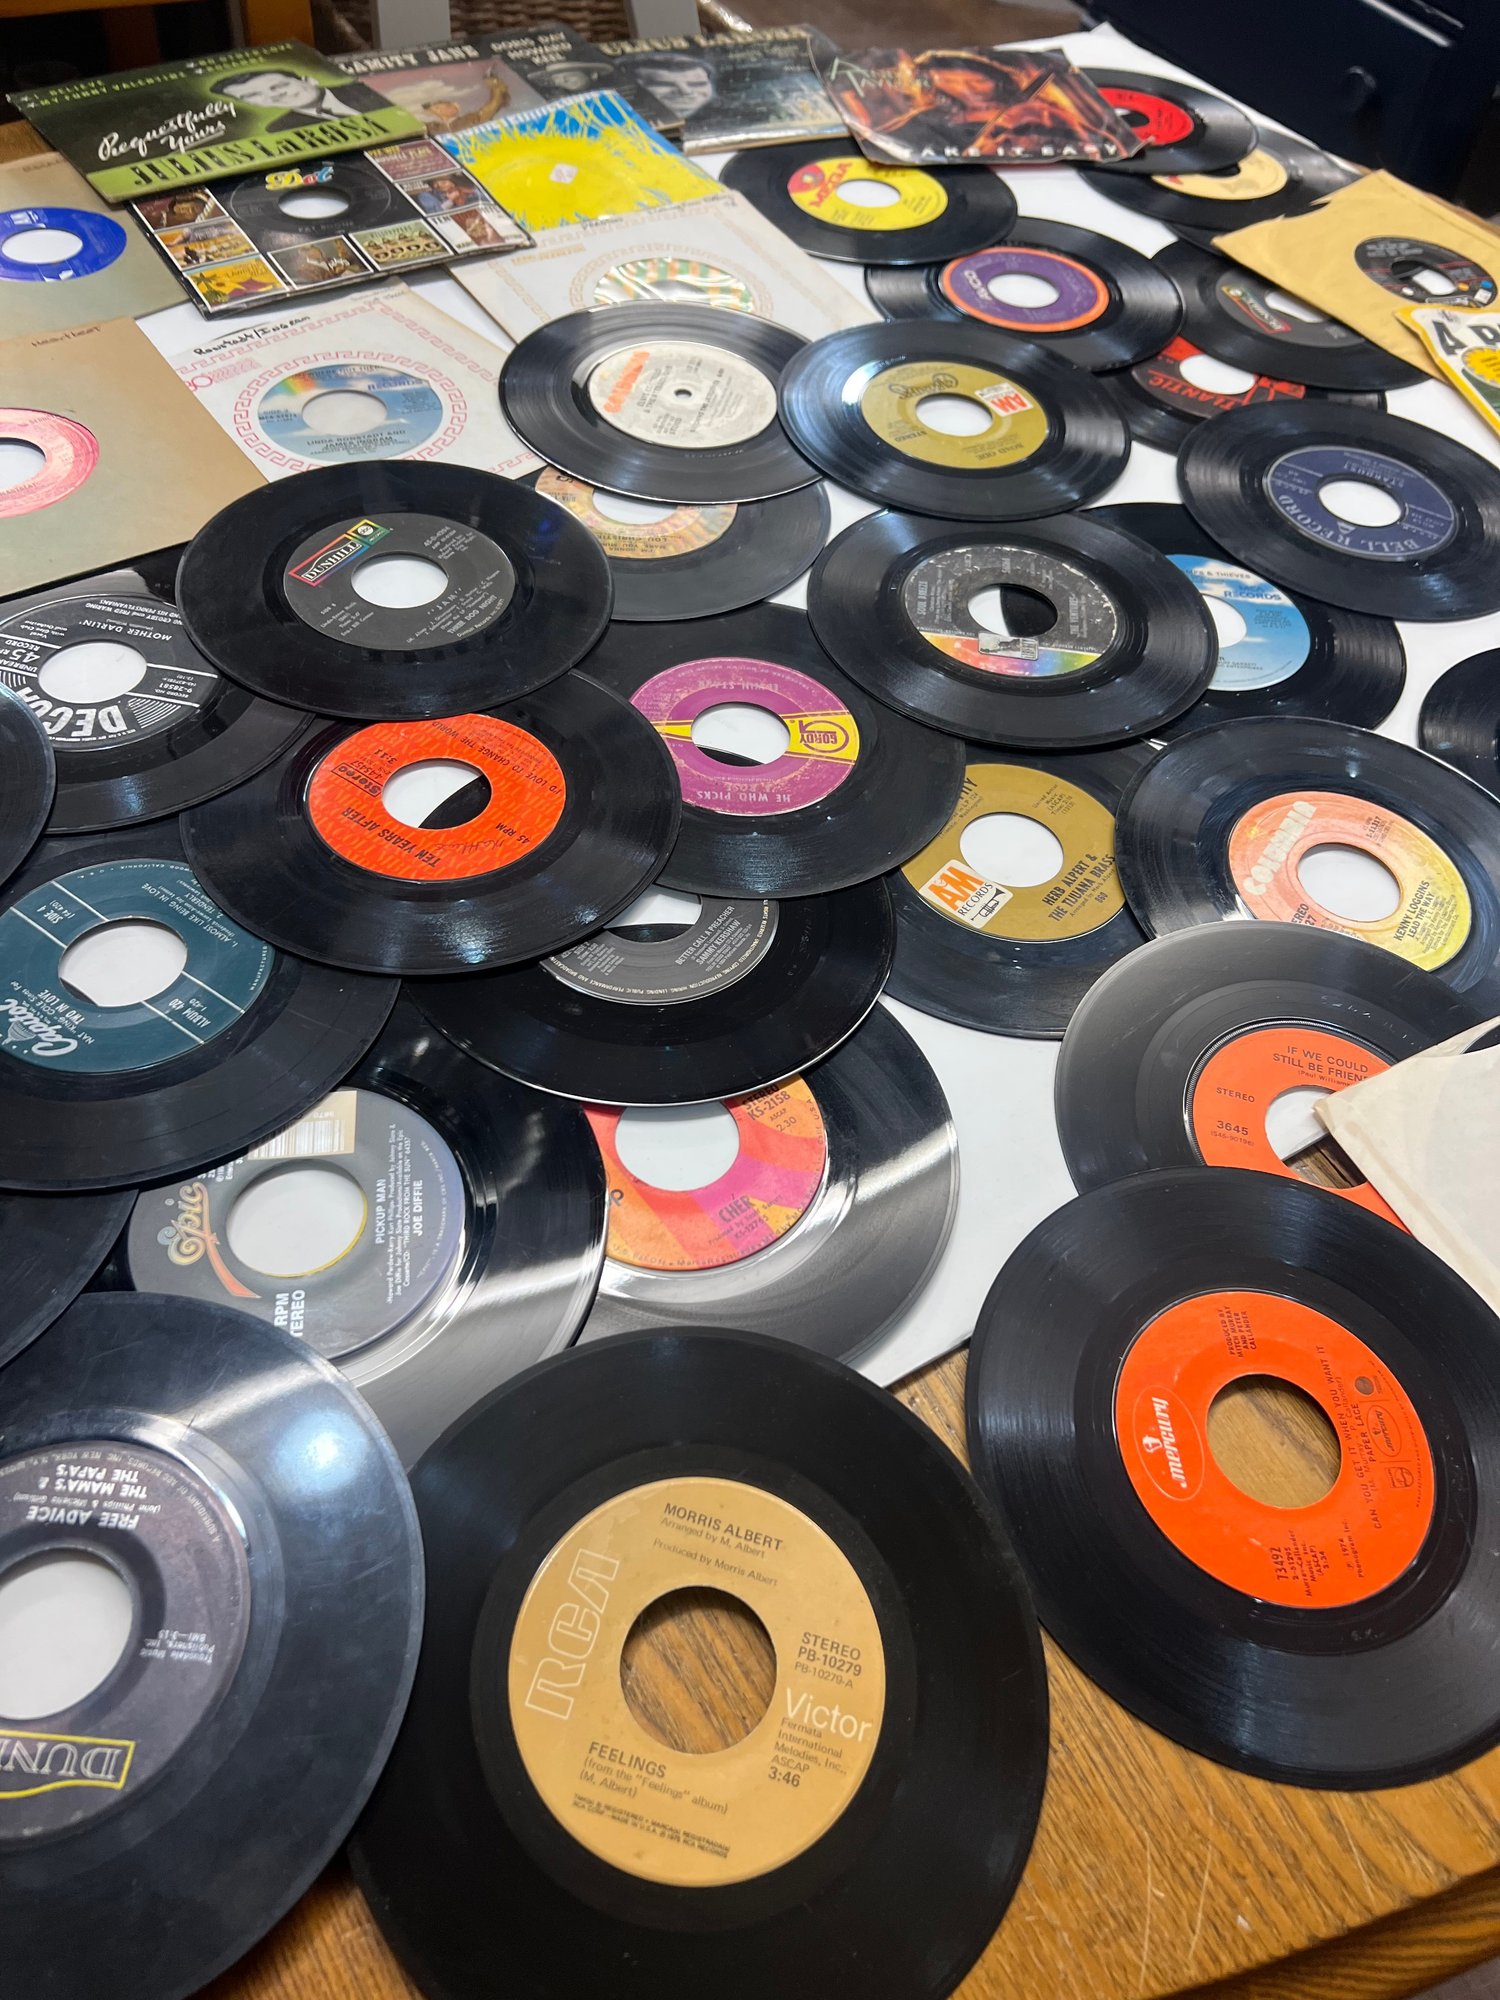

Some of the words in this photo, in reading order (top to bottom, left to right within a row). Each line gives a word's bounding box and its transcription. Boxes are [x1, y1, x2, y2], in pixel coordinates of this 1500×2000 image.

[426, 45, 479, 63] JANE
[50, 80, 105, 96] BELIEVE
[65, 87, 107, 101] FUNNY
[112, 72, 187, 90] VALENTINE
[161, 120, 225, 153] Yours
[997, 146, 1025, 157] IT
[130, 143, 255, 186] JULIUS
[336, 434, 383, 442] RONSTADT
[1278, 494, 1351, 546] RECORD
[1361, 539, 1420, 552] BELL
[305, 542, 359, 580] DUNHILL
[1216, 571, 1250, 579] THIEVES
[84, 601, 112, 611] WARING
[99, 598, 156, 613] PENNSYLVANIANS
[1224, 591, 1282, 600] RECORDS
[112, 607, 130, 615] FRED
[130, 610, 145, 618] and
[146, 613, 171, 623] CROSBY
[78, 619, 123, 633] DARLIN'
[126, 627, 172, 641] MOTHER
[4, 639, 41, 652] RECORD
[10, 649, 41, 664] 45
[159, 683, 192, 693] 9-28581
[431, 721, 460, 738] WORLD
[800, 733, 838, 744] GORDY
[374, 749, 398, 763] 3:11
[478, 747, 510, 765] CHANGE
[337, 765, 382, 795] Stereo
[525, 771, 548, 787] LOVE
[697, 791, 731, 800] PICKS
[750, 793, 774, 801] WHO
[776, 794, 791, 802] HE
[341, 807, 381, 832] AFTER
[495, 822, 517, 838] RPM
[377, 829, 416, 854] YEARS
[418, 851, 440, 868] TEN
[140, 880, 160, 898] LOVE
[1042, 885, 1065, 906] HERB
[1066, 859, 1090, 890] ALPERT
[158, 892, 169, 904] IN
[168, 898, 190, 918] BEING
[183, 888, 215, 915] TENDERLY
[958, 882, 994, 916] RECORDS
[1048, 903, 1068, 922] THE
[1063, 878, 1091, 907] TIJUANA
[187, 911, 204, 927] LIKE
[1394, 915, 1411, 941] KENNY
[1408, 880, 1430, 916] LOGGINS
[1407, 919, 1421, 939] LEAD
[1416, 904, 1428, 920] THE
[1422, 891, 1436, 909] WAY
[202, 921, 231, 946] ALMOST
[675, 945, 694, 966] BETTER
[692, 934, 706, 950] CALL
[709, 905, 735, 932] PREACHER
[696, 944, 717, 966] SAMMY
[715, 920, 741, 946] KERSHAW
[35, 997, 56, 1017] COLE
[37, 985, 60, 1008] LOVE
[56, 1000, 69, 1014] IN
[65, 1007, 85, 1025] TWO
[76, 1029, 95, 1046] NAT
[1273, 1053, 1303, 1068] STILL
[1308, 1062, 1323, 1073] BE
[1287, 1046, 1297, 1055] IF
[1302, 1050, 1322, 1062] WE
[1327, 1056, 1368, 1073] COULD
[747, 1090, 791, 1120] KS-2158
[1216, 1087, 1255, 1103] STEREO
[1217, 1121, 1248, 1136] 3645
[377, 1178, 386, 1202] MAN
[413, 1179, 423, 1212] DIFFIE
[157, 1181, 220, 1265] Epic
[375, 1205, 385, 1244] PICKUP
[413, 1215, 423, 1236] JOE
[274, 1292, 290, 1327] RPM
[1224, 1305, 1238, 1334] MURRAY
[1221, 1319, 1235, 1355] PRODUCED
[1233, 1335, 1244, 1359] MITCH
[1314, 1343, 1325, 1355] IT
[1319, 1356, 1334, 1385] WANT
[1329, 1387, 1342, 1408] YOU
[1350, 1401, 1364, 1427] LACE
[1336, 1411, 1352, 1441] WHEN
[1151, 1396, 1188, 1489] mercury
[1347, 1444, 1357, 1456] IT
[1359, 1429, 1376, 1464] PAPER
[54, 1461, 106, 1479] PAPA'S
[112, 1467, 139, 1482] THE
[1352, 1458, 1365, 1479] GET
[53, 1476, 115, 1495] MAMA'S
[118, 1483, 148, 1498] THE
[1360, 1481, 1373, 1503] YOU
[25, 1503, 92, 1525] ADVICE
[97, 1510, 140, 1530] FREE
[1368, 1507, 1382, 1530] CAN
[663, 1502, 721, 1531] MORRIS
[724, 1523, 783, 1551] ALBERT
[661, 1517, 703, 1538] Arranged
[705, 1531, 718, 1544] by
[734, 1540, 765, 1559] Albert
[652, 1537, 698, 1560] Produced
[699, 1553, 712, 1566] by
[714, 1558, 745, 1576] Morris
[747, 1568, 778, 1587] Albert
[1268, 1545, 1288, 1581] 73492
[525, 1549, 620, 1720] RCA
[801, 1632, 861, 1661] STEREO
[797, 1646, 862, 1677] PB-10279
[794, 1661, 853, 1689] PB-10279-A
[785, 1687, 873, 1743] Victor
[780, 1718, 823, 1739] Fermata
[777, 1729, 843, 1759] International
[588, 1741, 667, 1779] FEELINGS
[771, 1754, 810, 1773] ASCAP
[583, 1756, 613, 1773] (from
[615, 1764, 633, 1779] the
[691, 1790, 729, 1816] album)
[599, 1775, 638, 1799] Albert)
[767, 1766, 801, 1788] 3:46
